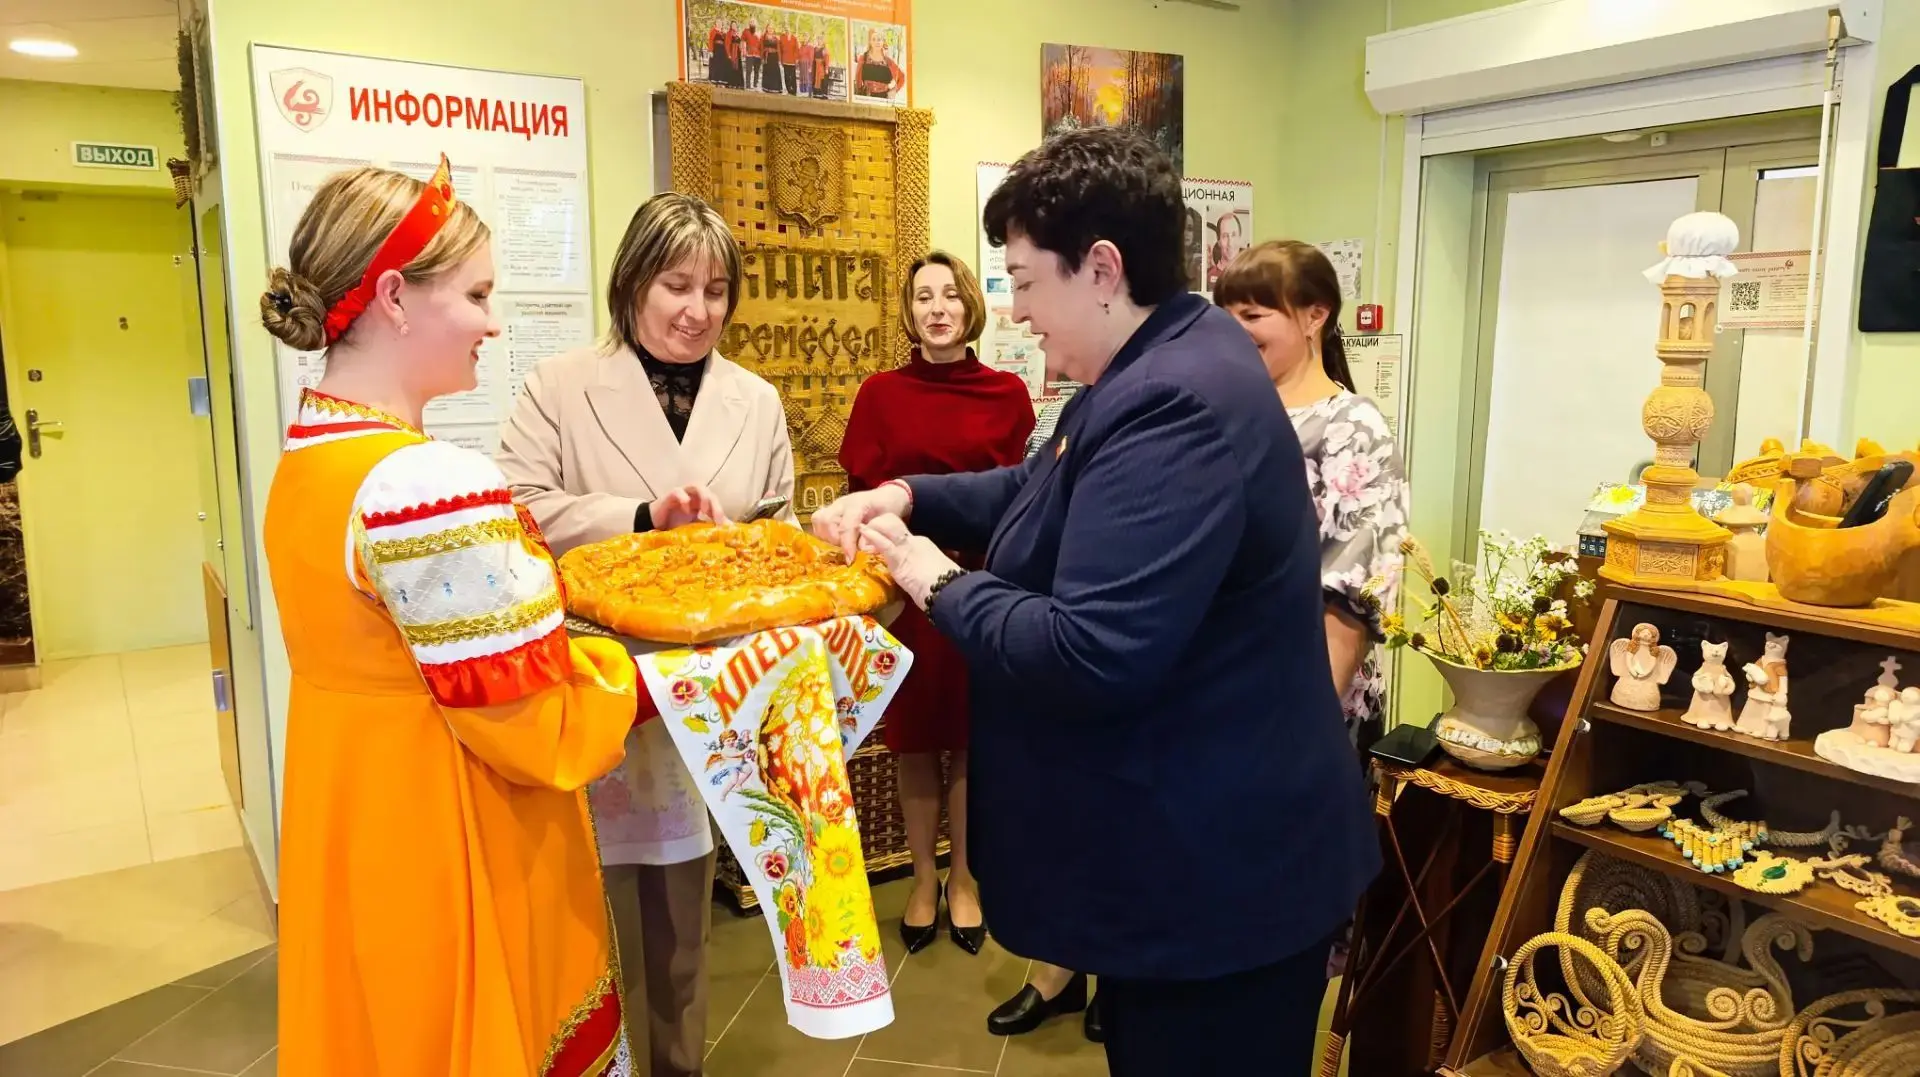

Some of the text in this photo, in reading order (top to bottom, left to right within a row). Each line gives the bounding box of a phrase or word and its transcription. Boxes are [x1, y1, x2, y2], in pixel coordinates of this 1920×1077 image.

[349, 87, 569, 141] ИНФОРМАЦИЯ
[80, 146, 151, 166] ВЫХОД
[709, 628, 801, 726] ХЛЕБ
